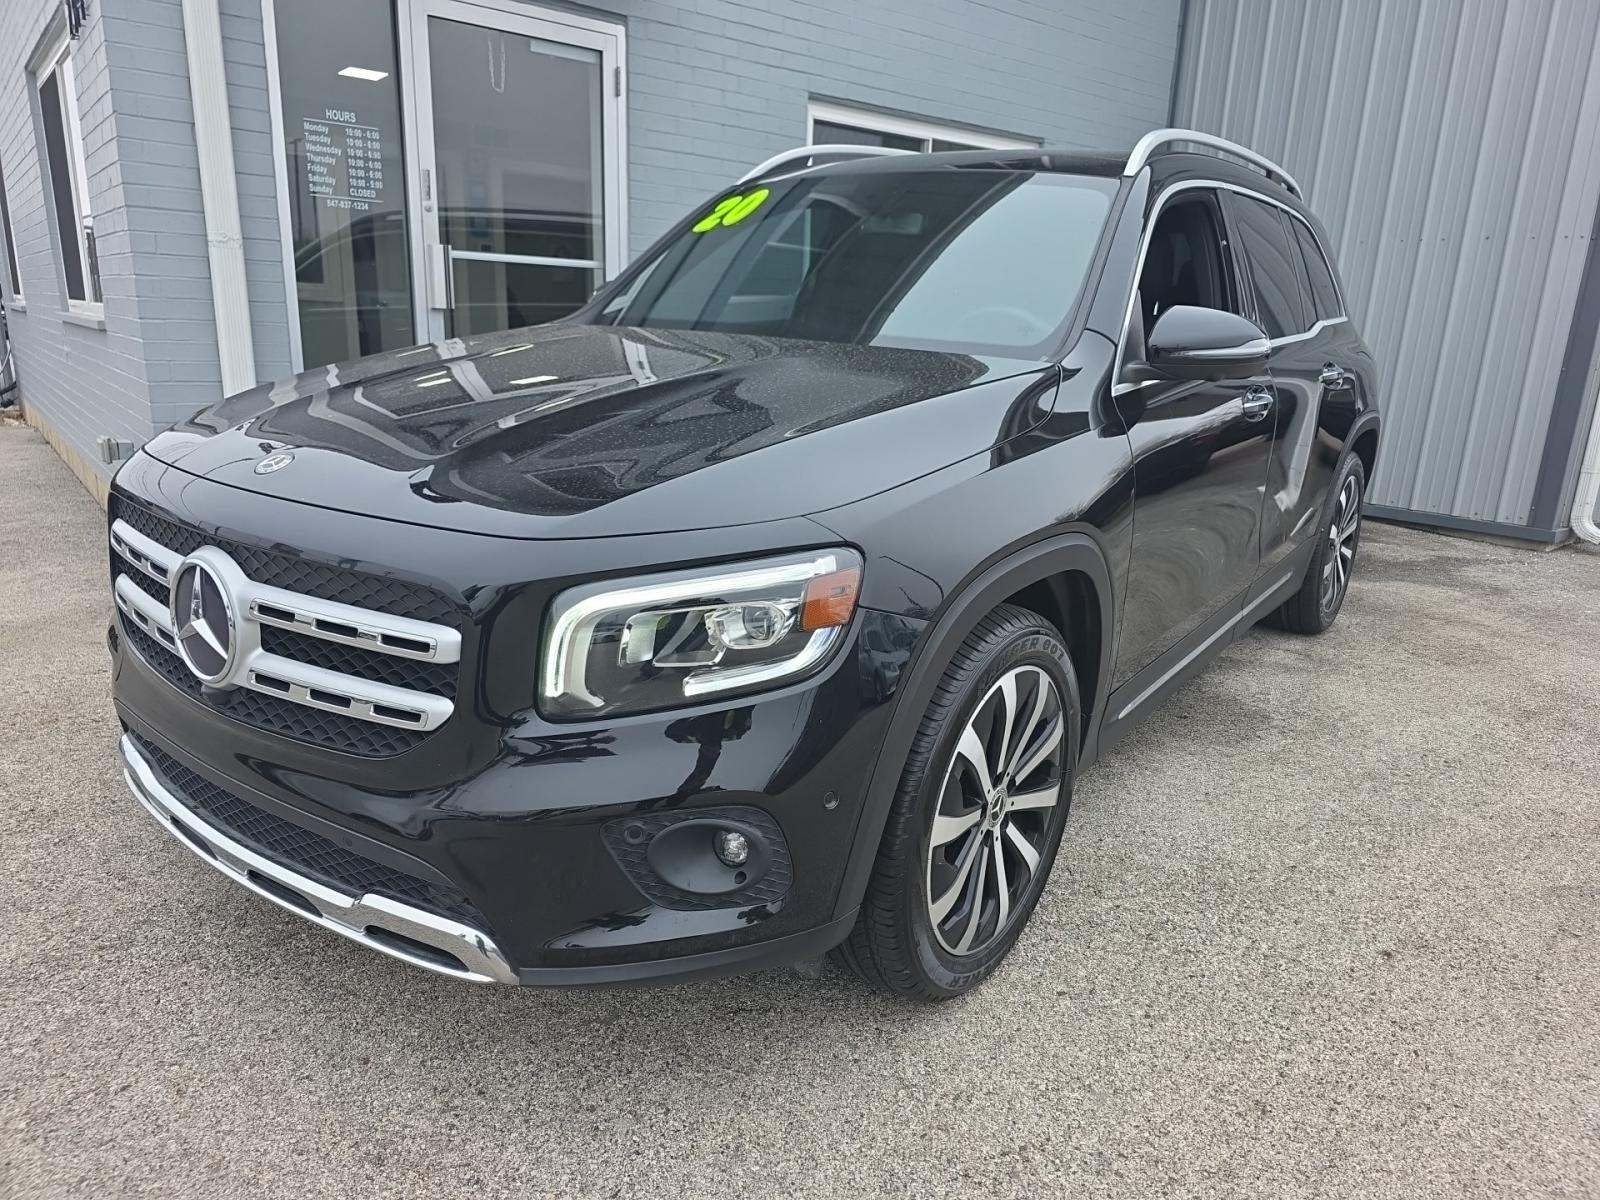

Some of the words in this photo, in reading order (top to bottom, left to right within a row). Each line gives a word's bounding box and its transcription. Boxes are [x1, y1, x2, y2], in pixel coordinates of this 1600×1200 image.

[325, 109, 356, 122] HOURS
[304, 122, 328, 134] Monday
[304, 133, 331, 145] Tuesday
[305, 143, 342, 156] Wednesday
[306, 153, 336, 165] Thursday
[307, 163, 328, 174] Friday
[308, 173, 336, 185] Saturday
[308, 183, 333, 195] Sunday
[349, 188, 377, 198] CLOSED
[692, 189, 769, 232] 20
